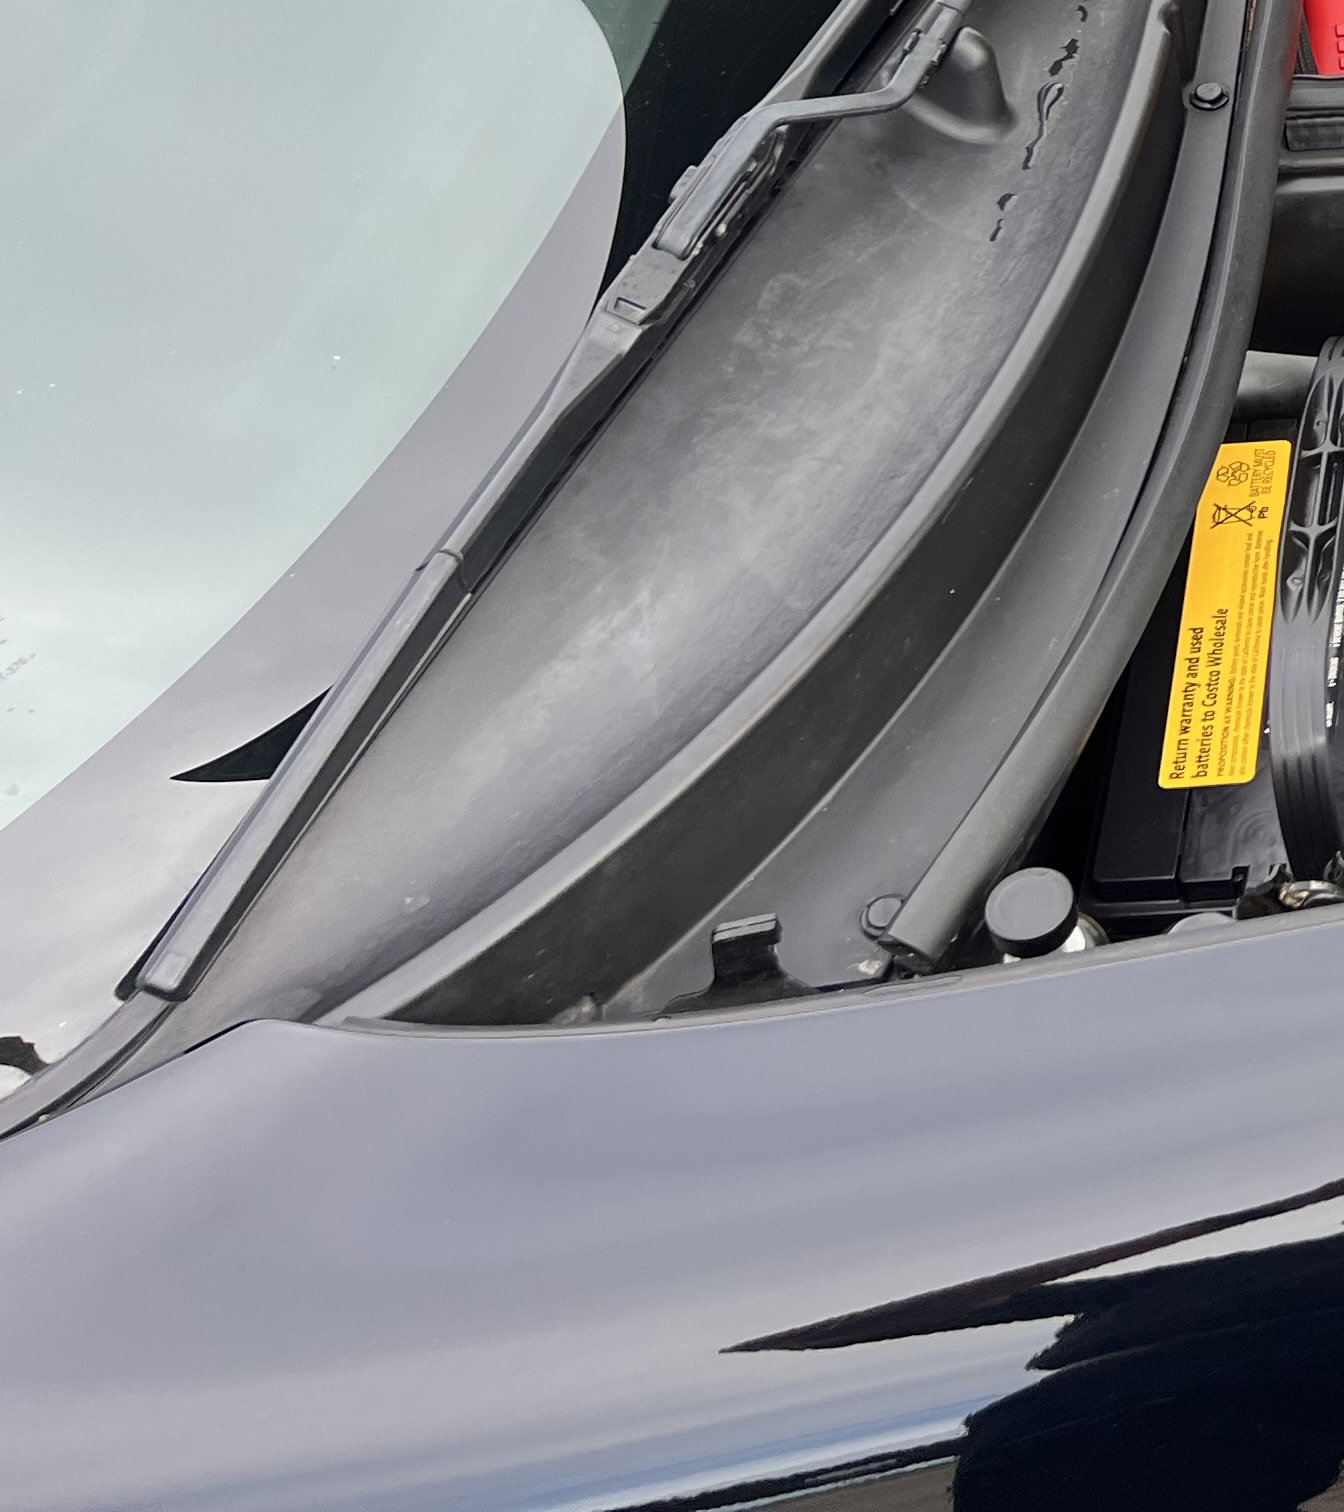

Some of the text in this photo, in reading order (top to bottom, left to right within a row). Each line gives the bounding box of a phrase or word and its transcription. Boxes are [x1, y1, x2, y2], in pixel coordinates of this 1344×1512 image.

[1257, 506, 1270, 520] Pb
[1168, 626, 1205, 780] Return warranty and used
[1191, 607, 1230, 779] batteries to Costco Wholesale
